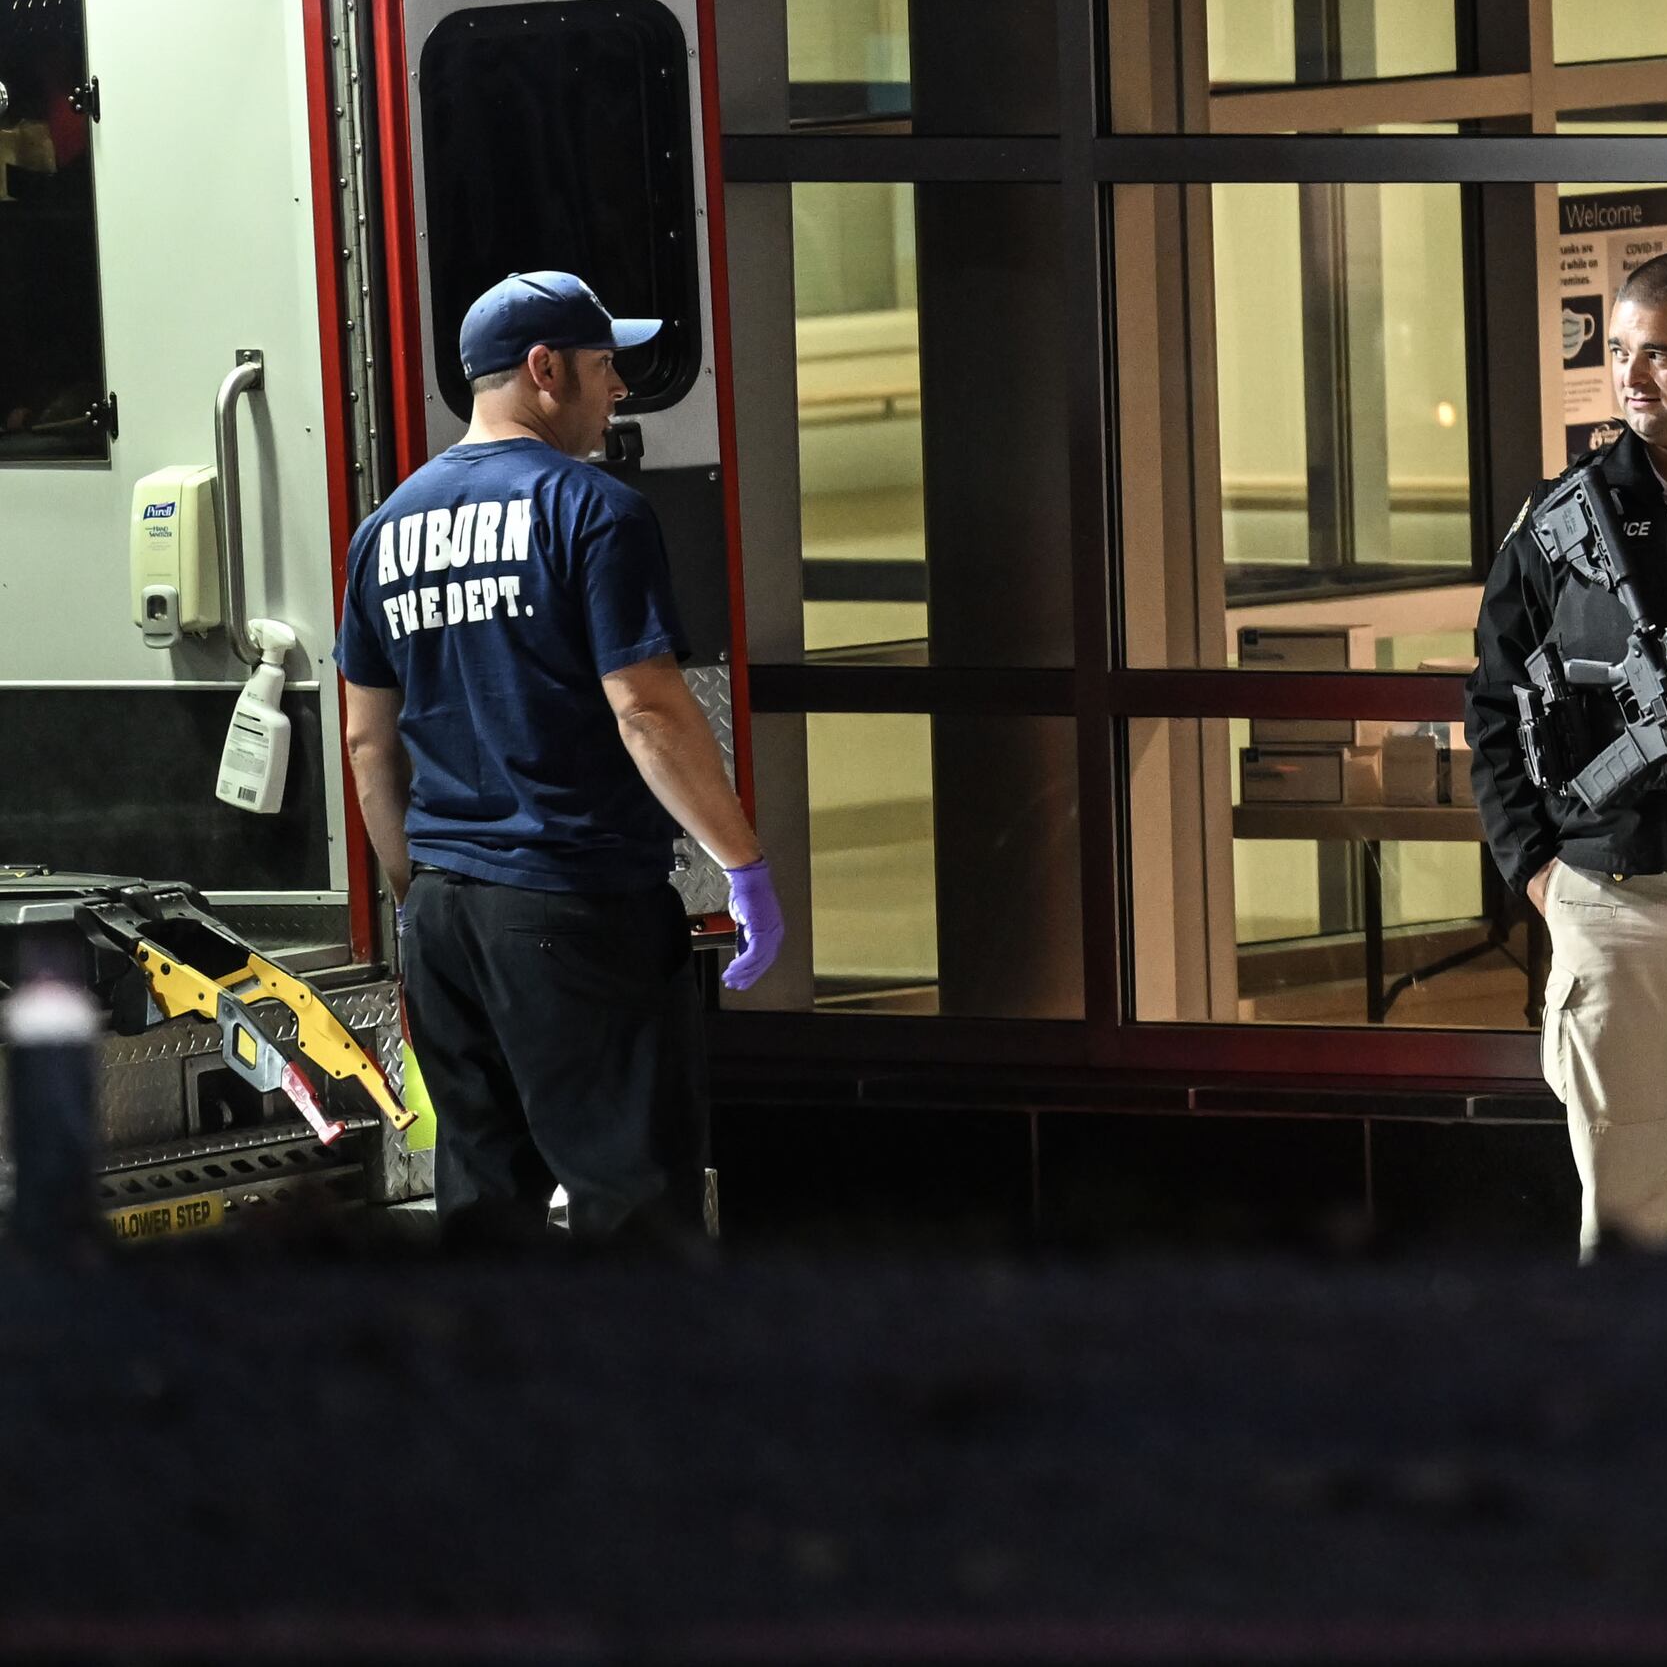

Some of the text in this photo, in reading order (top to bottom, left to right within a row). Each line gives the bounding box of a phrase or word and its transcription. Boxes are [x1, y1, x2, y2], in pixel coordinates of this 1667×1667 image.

[1565, 202, 1643, 229] Welcome
[147, 506, 173, 517] Purell
[378, 499, 532, 587] AUBURN
[446, 575, 534, 626] DEPT.
[176, 1200, 211, 1229] STEP
